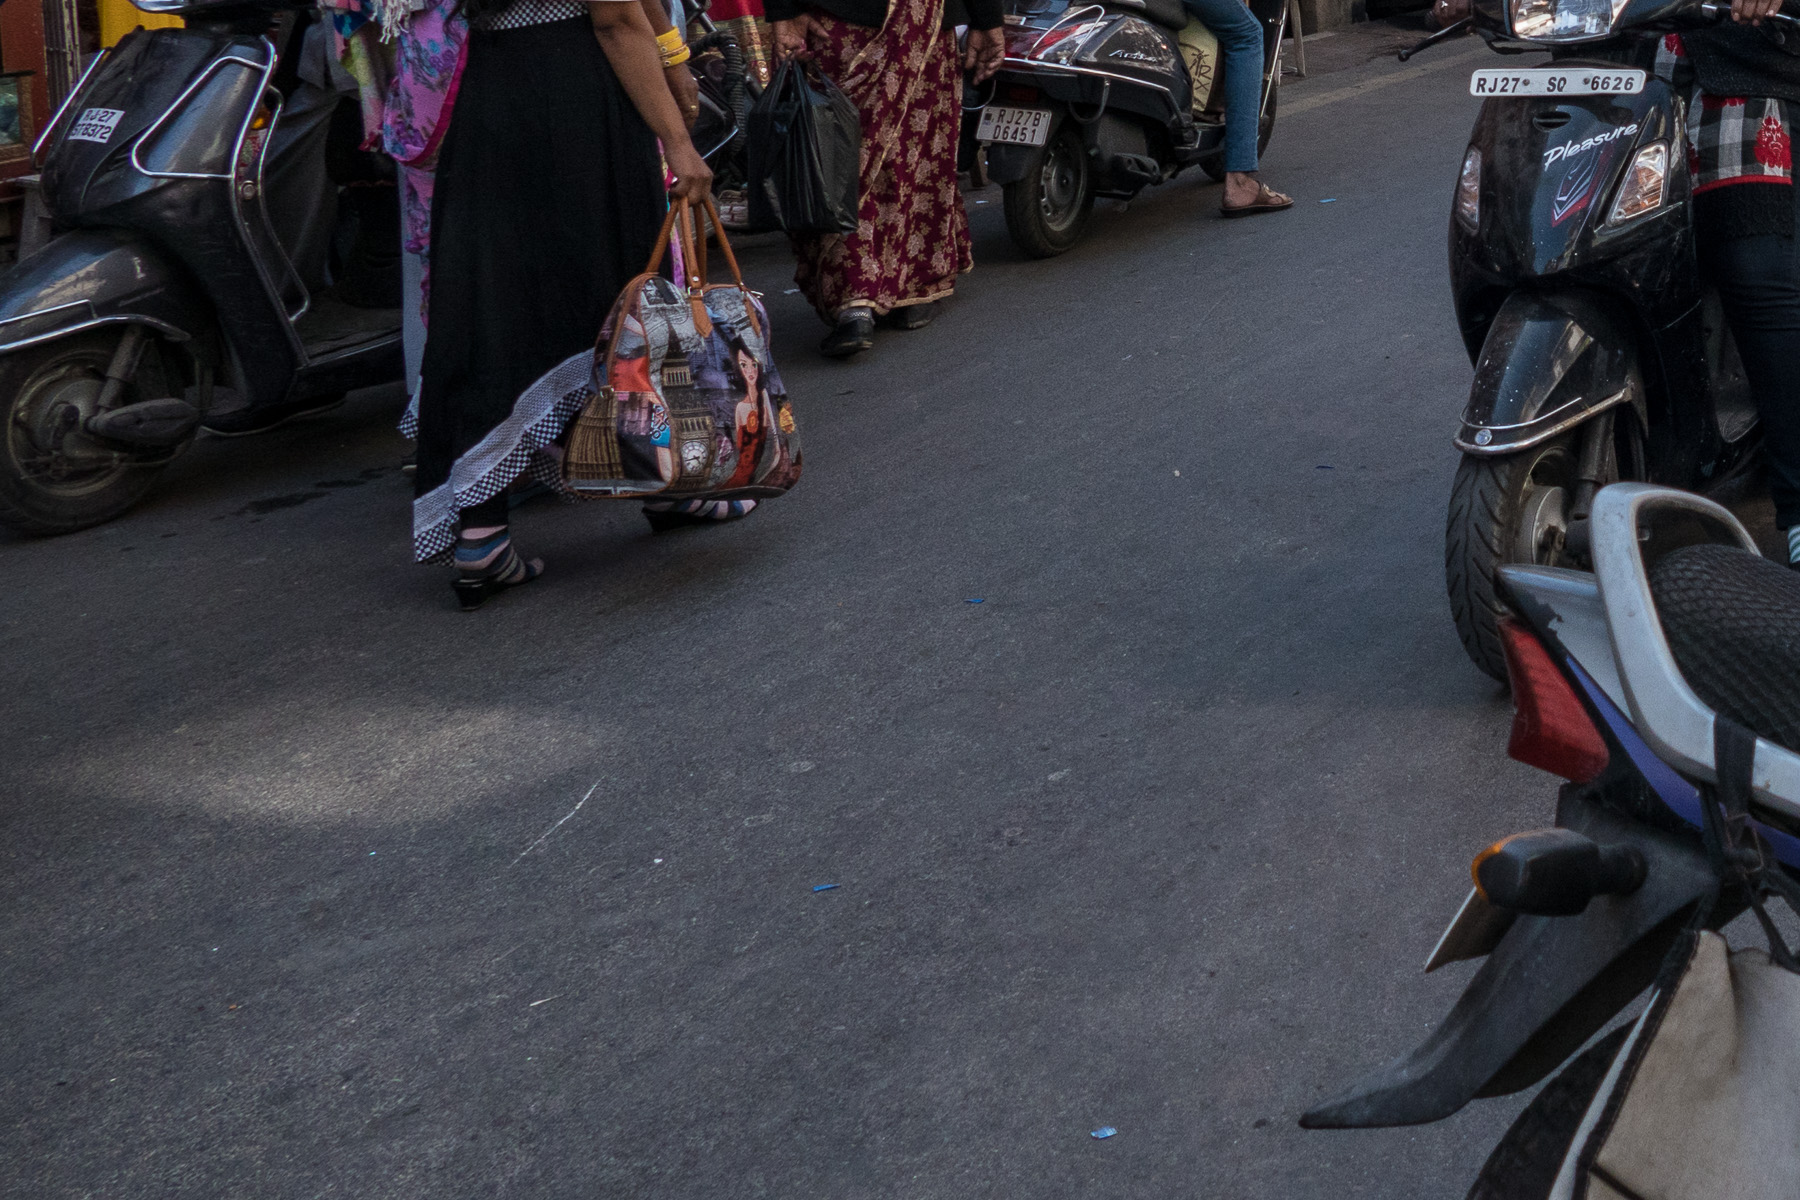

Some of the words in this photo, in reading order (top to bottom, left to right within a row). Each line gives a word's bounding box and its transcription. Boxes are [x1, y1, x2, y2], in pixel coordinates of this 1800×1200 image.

[1476, 76, 1520, 94] RJ27
[1546, 76, 1568, 94] SQ
[1589, 74, 1636, 92] 6626
[997, 108, 1042, 127] RJ27B
[1543, 123, 1638, 168] Pleasure
